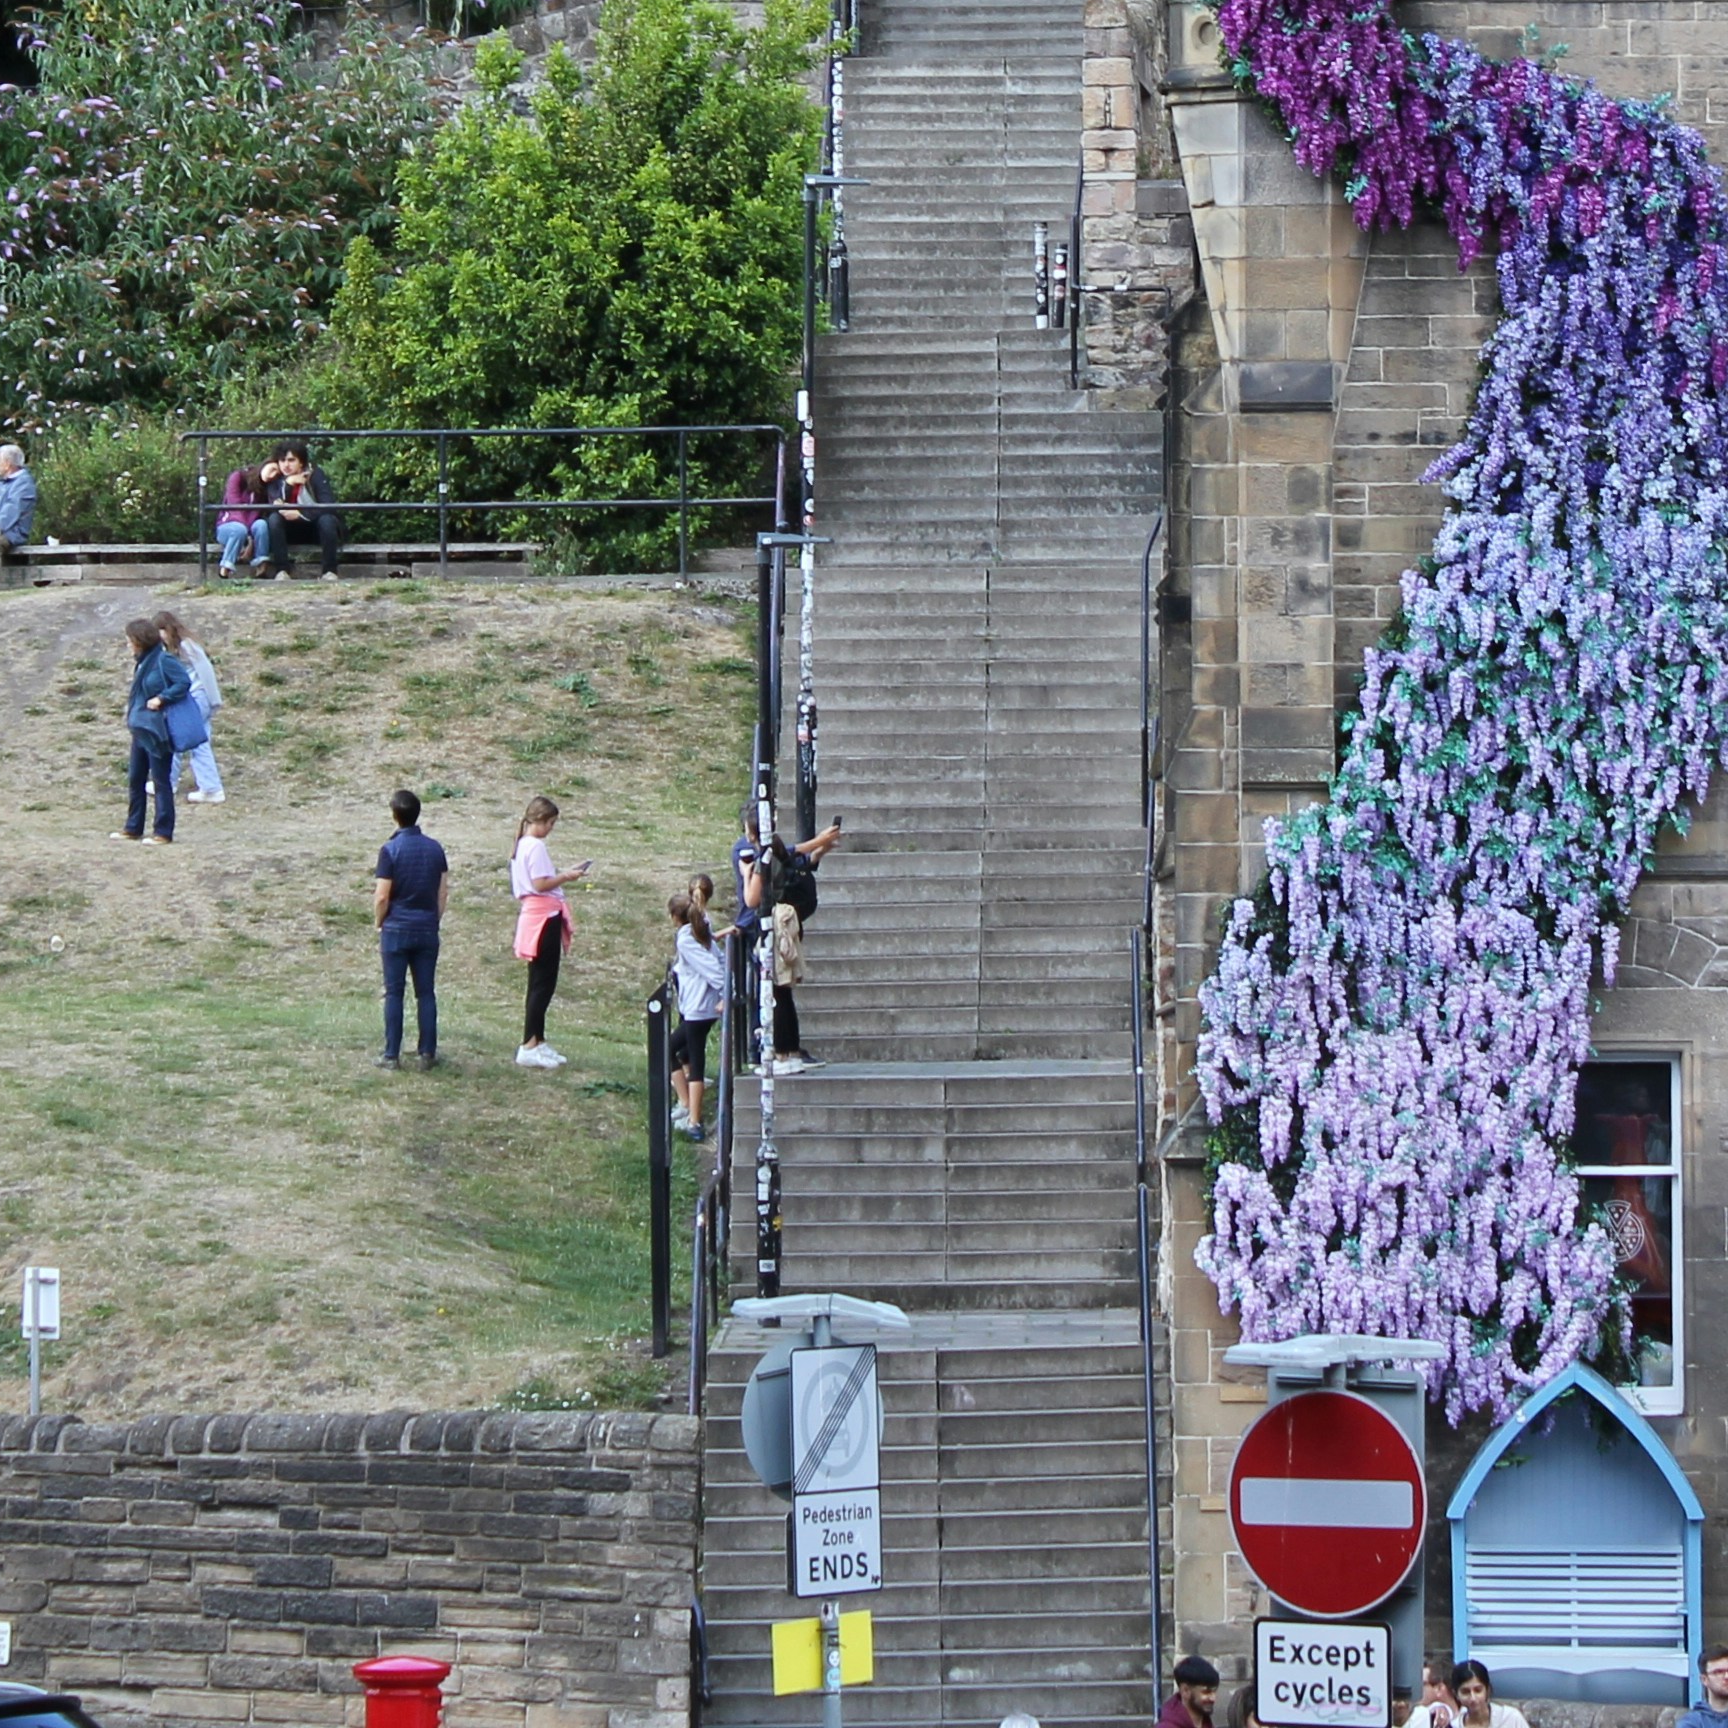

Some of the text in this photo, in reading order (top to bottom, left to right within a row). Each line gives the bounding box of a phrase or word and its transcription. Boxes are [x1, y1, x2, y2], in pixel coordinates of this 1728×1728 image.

[802, 1504, 872, 1525] Pedestrian
[822, 1528, 854, 1546] Zone
[809, 1552, 868, 1583] ENDS
[1268, 1635, 1375, 1672] Except
[1274, 1678, 1371, 1709] cycles
